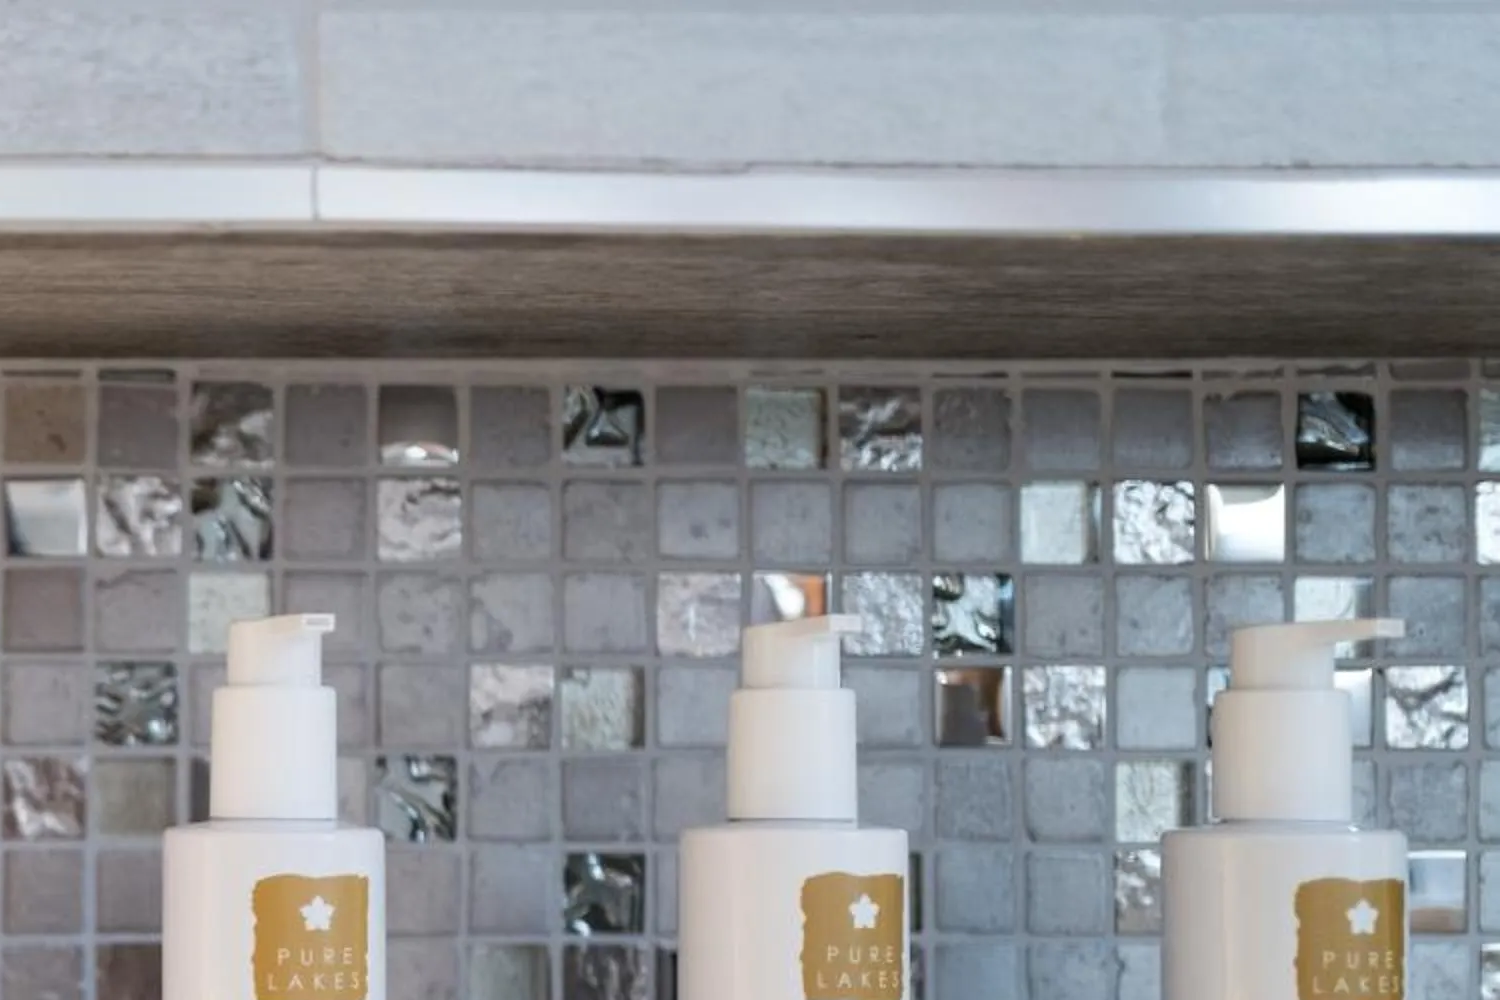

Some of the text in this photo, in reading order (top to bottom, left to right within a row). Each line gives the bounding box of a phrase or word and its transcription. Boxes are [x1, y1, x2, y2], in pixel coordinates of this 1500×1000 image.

[277, 947, 352, 966] PURE
[827, 945, 894, 963] PURE
[1322, 951, 1394, 970] PURE
[267, 972, 360, 991] LAKES
[816, 971, 900, 989] LAKES
[1313, 976, 1399, 994] LAKES
